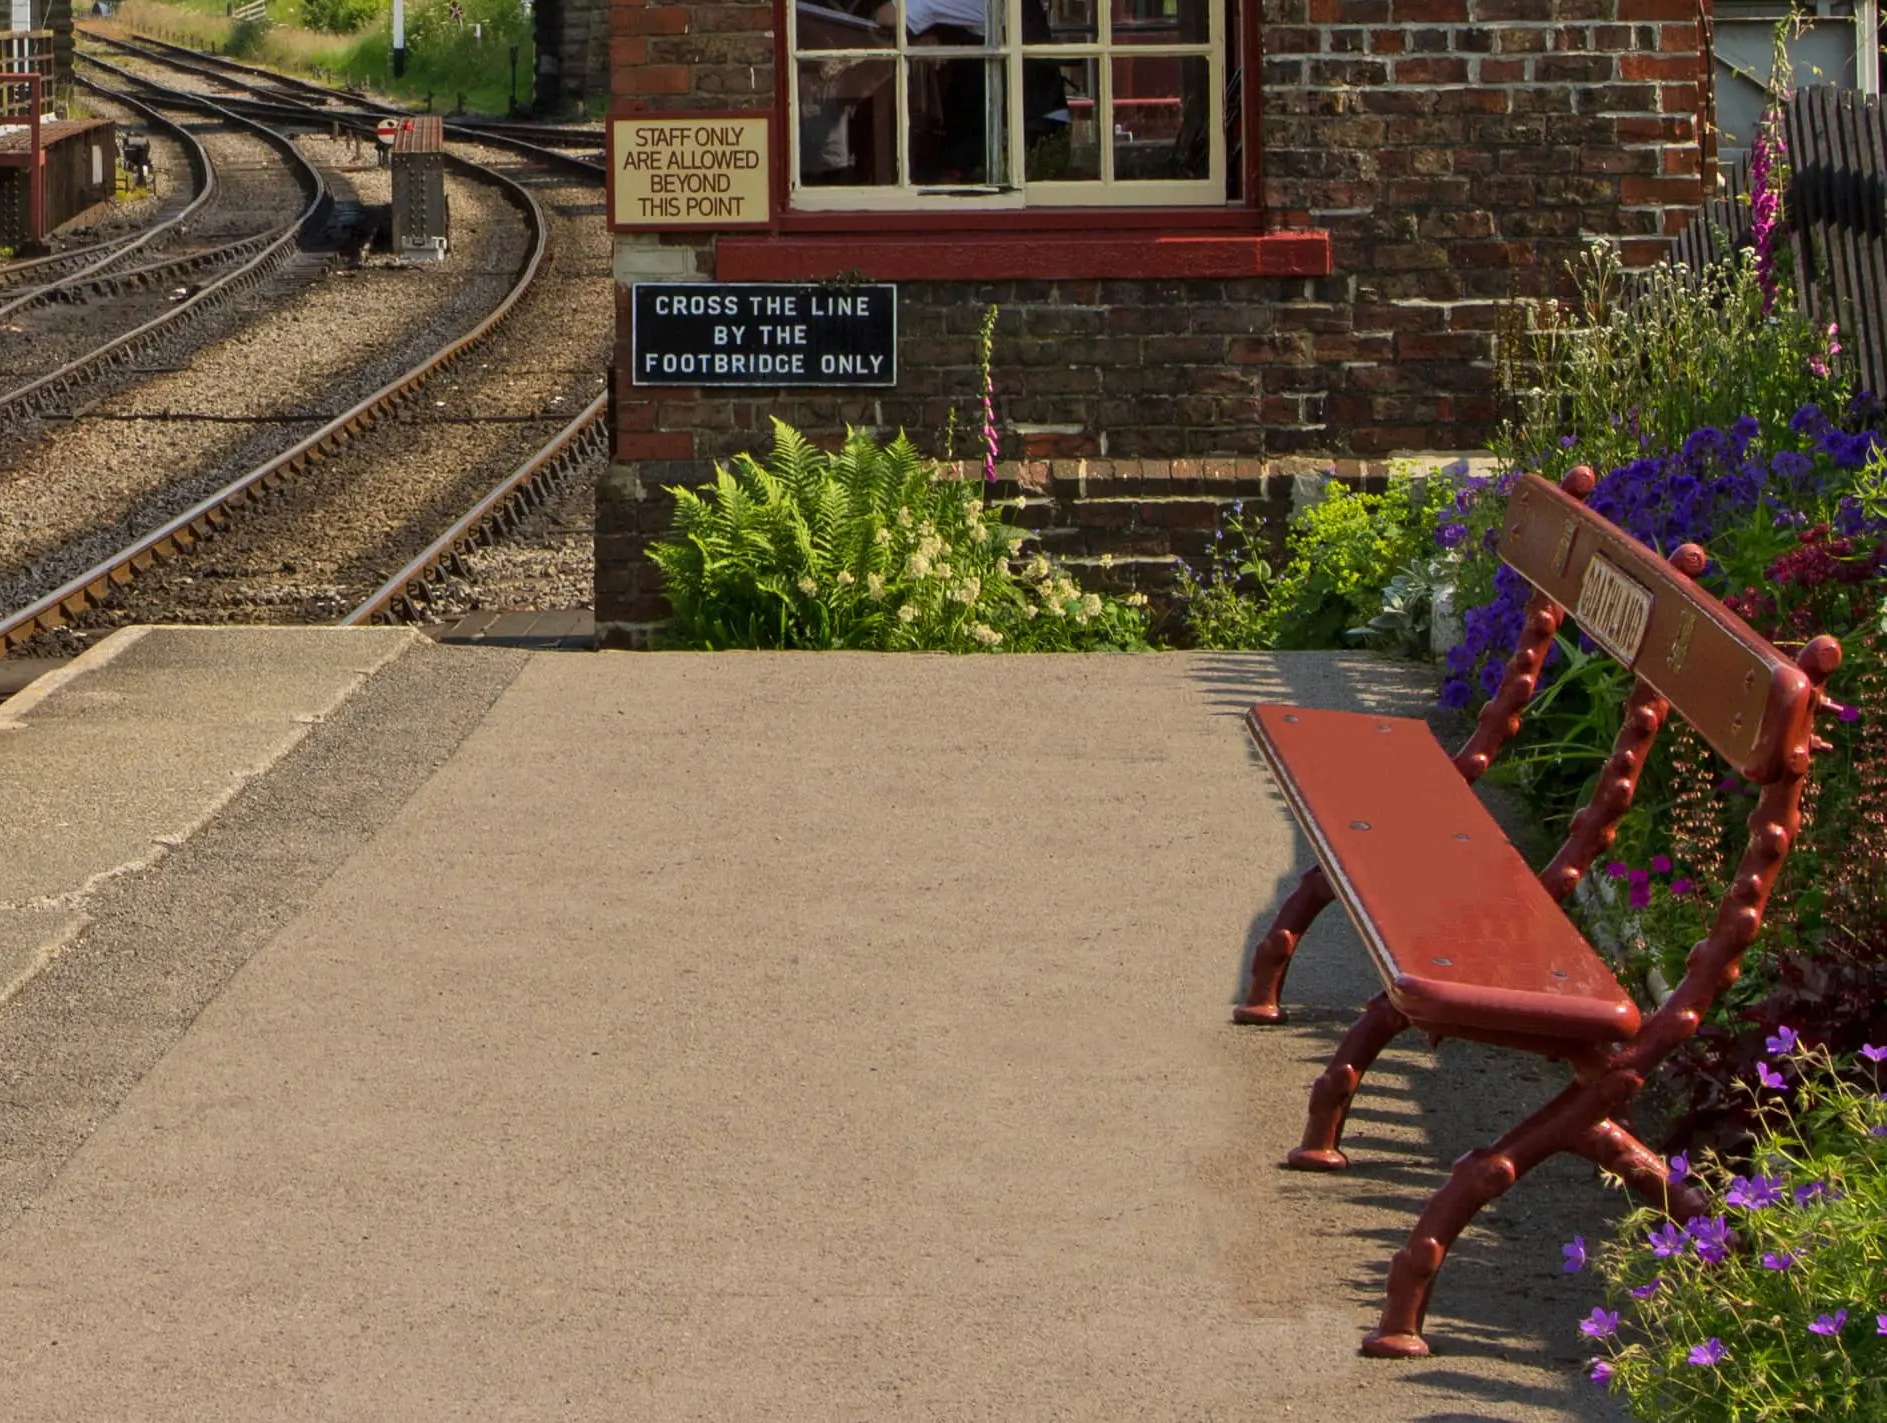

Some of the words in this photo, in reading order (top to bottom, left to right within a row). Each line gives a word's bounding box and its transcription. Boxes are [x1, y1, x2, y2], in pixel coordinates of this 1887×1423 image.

[635, 127, 692, 148] STAFF
[695, 127, 745, 147] ONLY
[623, 150, 663, 171] ARE
[666, 150, 760, 171] ALLOWED
[650, 173, 731, 194] BEYOND
[637, 197, 681, 217] THIS
[686, 196, 745, 217] POINT
[655, 296, 739, 316] CROSS
[749, 296, 797, 316] THE
[811, 296, 870, 316] LINE
[714, 325, 746, 345] BY
[758, 325, 807, 345] THE
[645, 353, 805, 374] FOOTBRIDGE
[821, 354, 884, 375] ONLY
